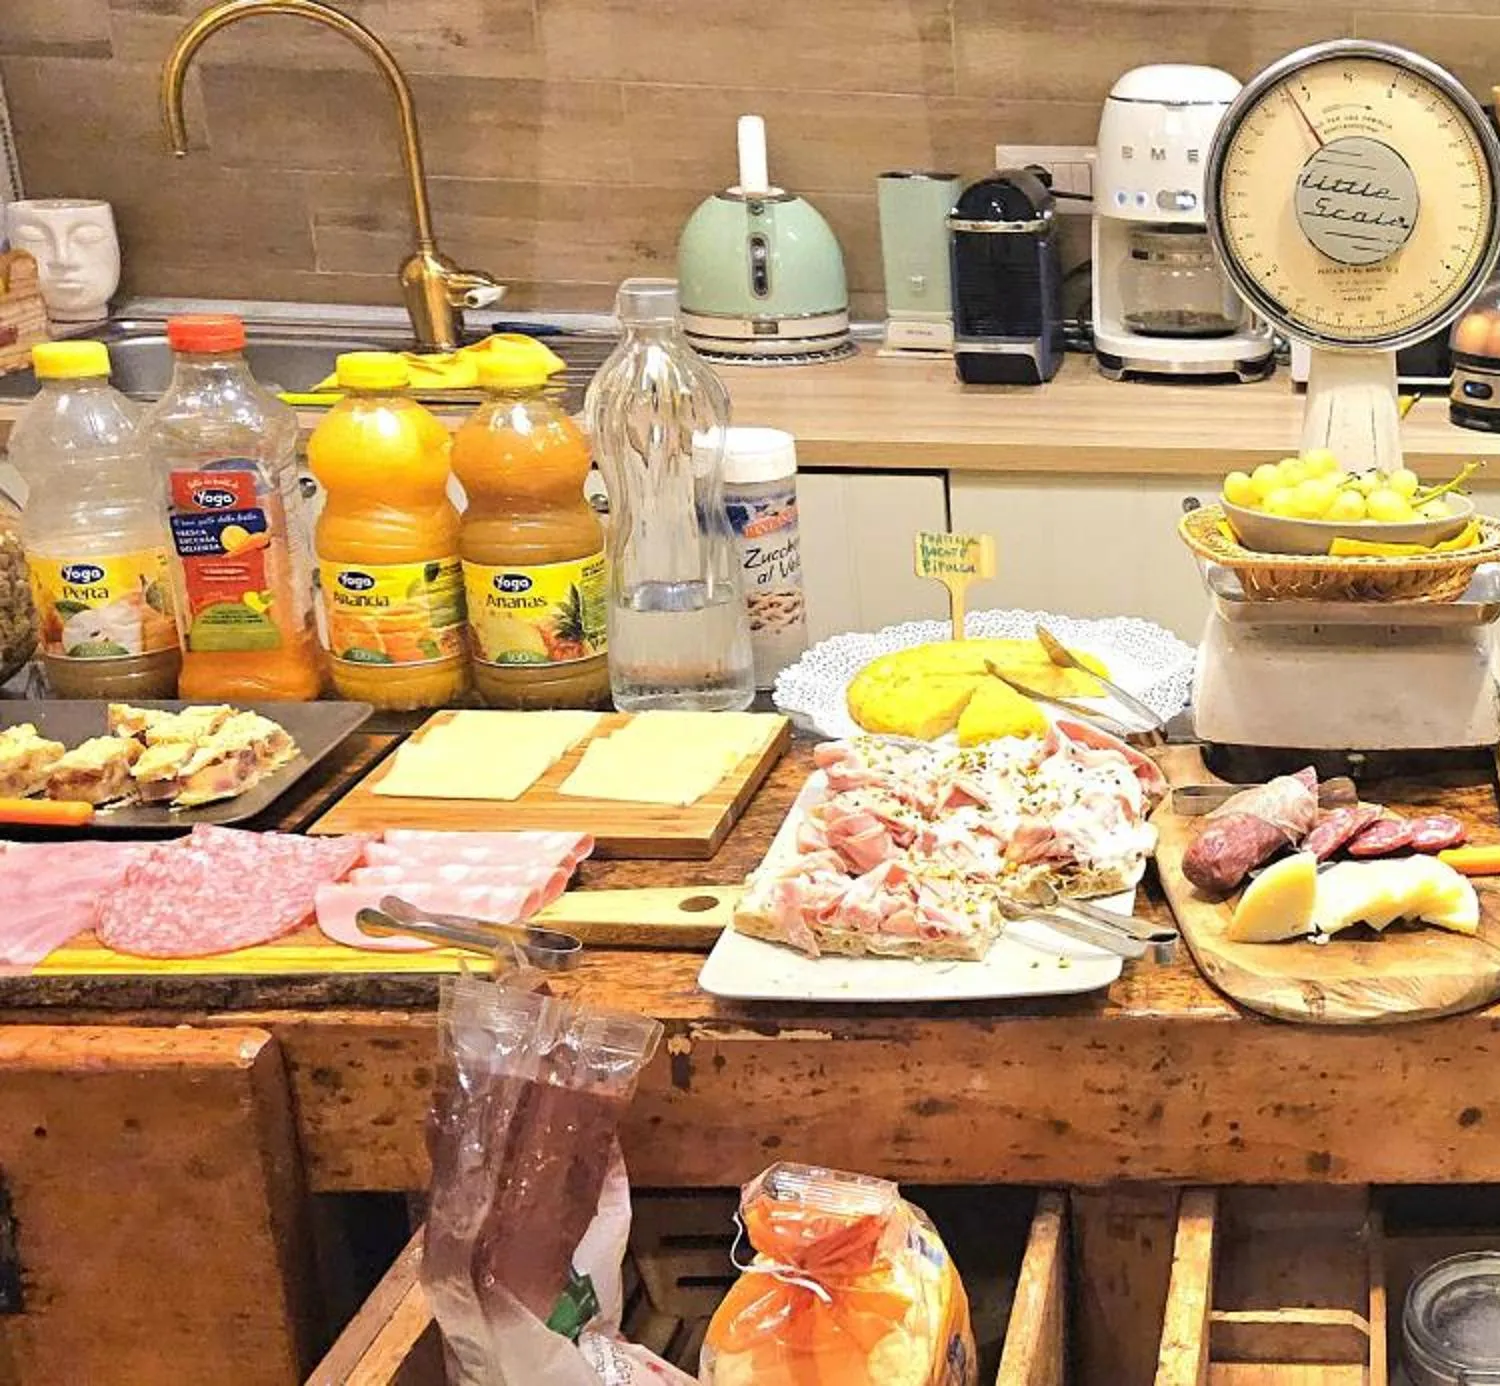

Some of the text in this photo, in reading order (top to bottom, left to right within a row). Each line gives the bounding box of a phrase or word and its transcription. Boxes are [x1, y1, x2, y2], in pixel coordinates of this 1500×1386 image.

[1121, 146, 1199, 162] SME
[193, 490, 233, 507] Yoga
[743, 539, 799, 569] Zucch
[63, 565, 101, 582] Yoga
[341, 572, 372, 588] Yoga
[757, 564, 775, 585] al
[496, 575, 530, 591] Yoga
[485, 593, 548, 609] Ananas
